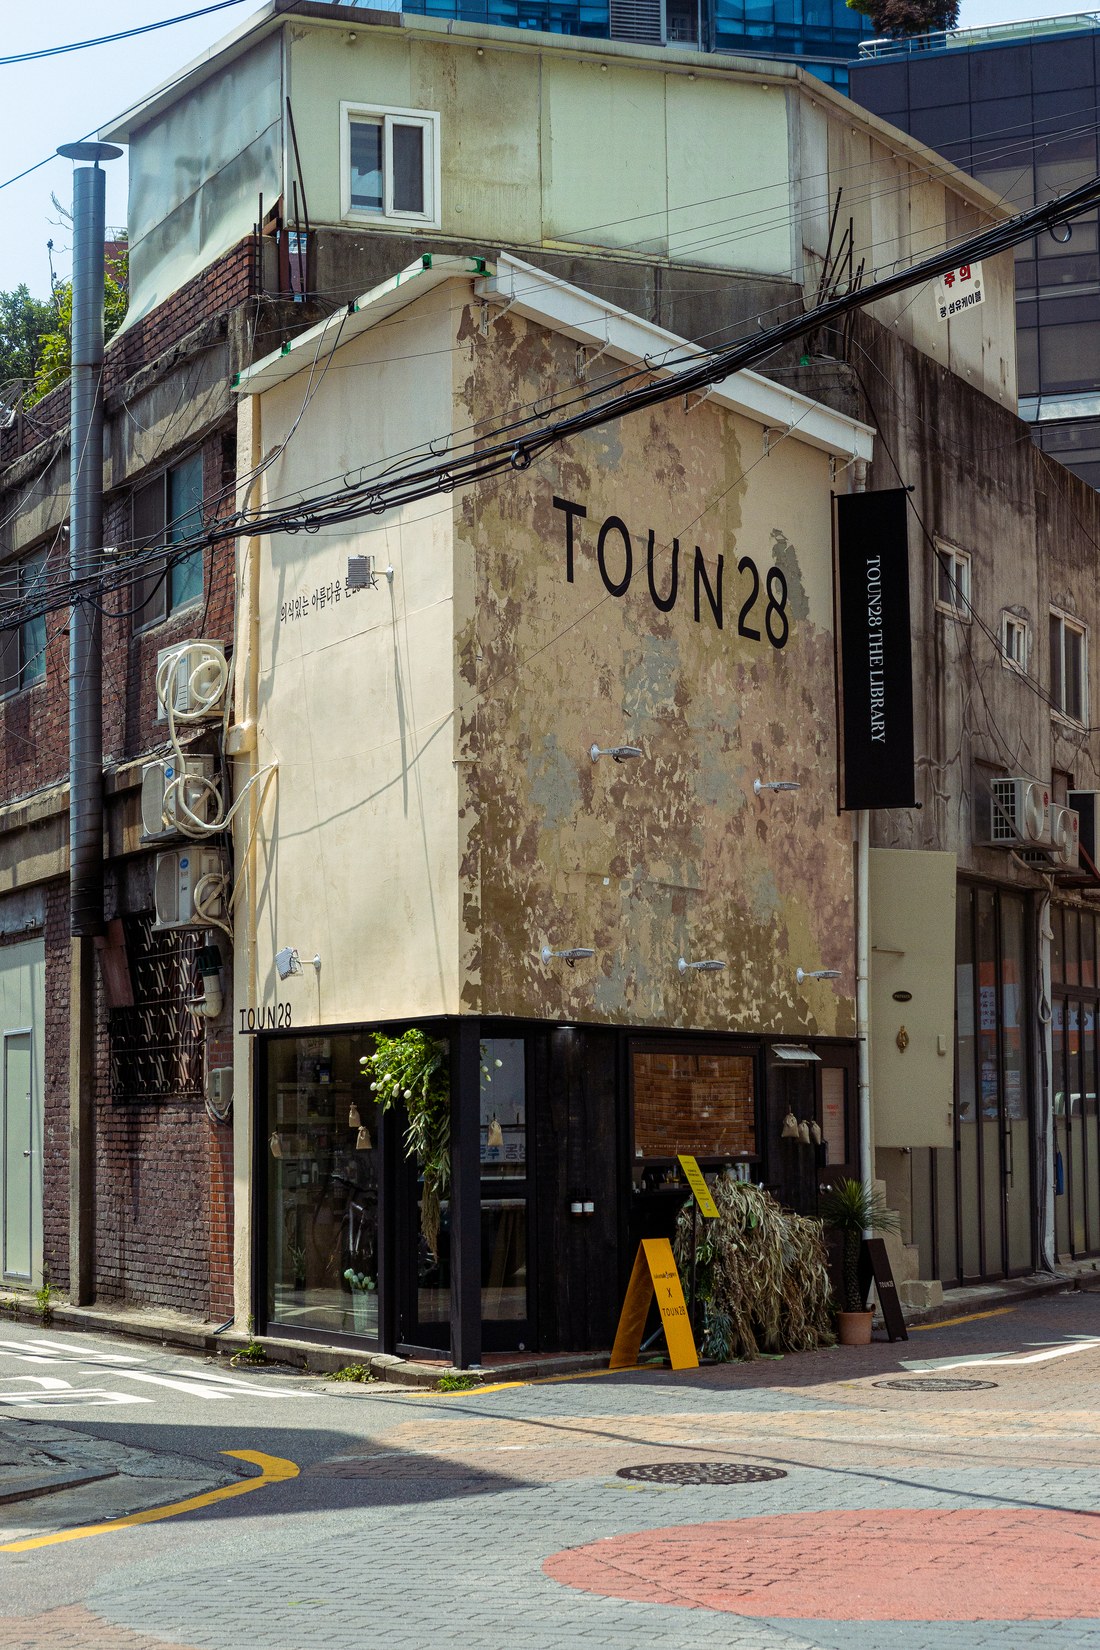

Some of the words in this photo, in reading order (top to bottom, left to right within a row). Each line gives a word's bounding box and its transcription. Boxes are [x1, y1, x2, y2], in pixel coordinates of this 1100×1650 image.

[552, 495, 789, 649] TOUN28
[866, 555, 882, 627] TOUN28
[280, 596, 310, 624] 의식있는
[312, 579, 342, 612] 아름다움
[868, 629, 883, 667] THE
[869, 669, 886, 744] LIBRARY
[239, 1002, 292, 1032] TOUN28
[661, 1305, 686, 1317] TOUN28
